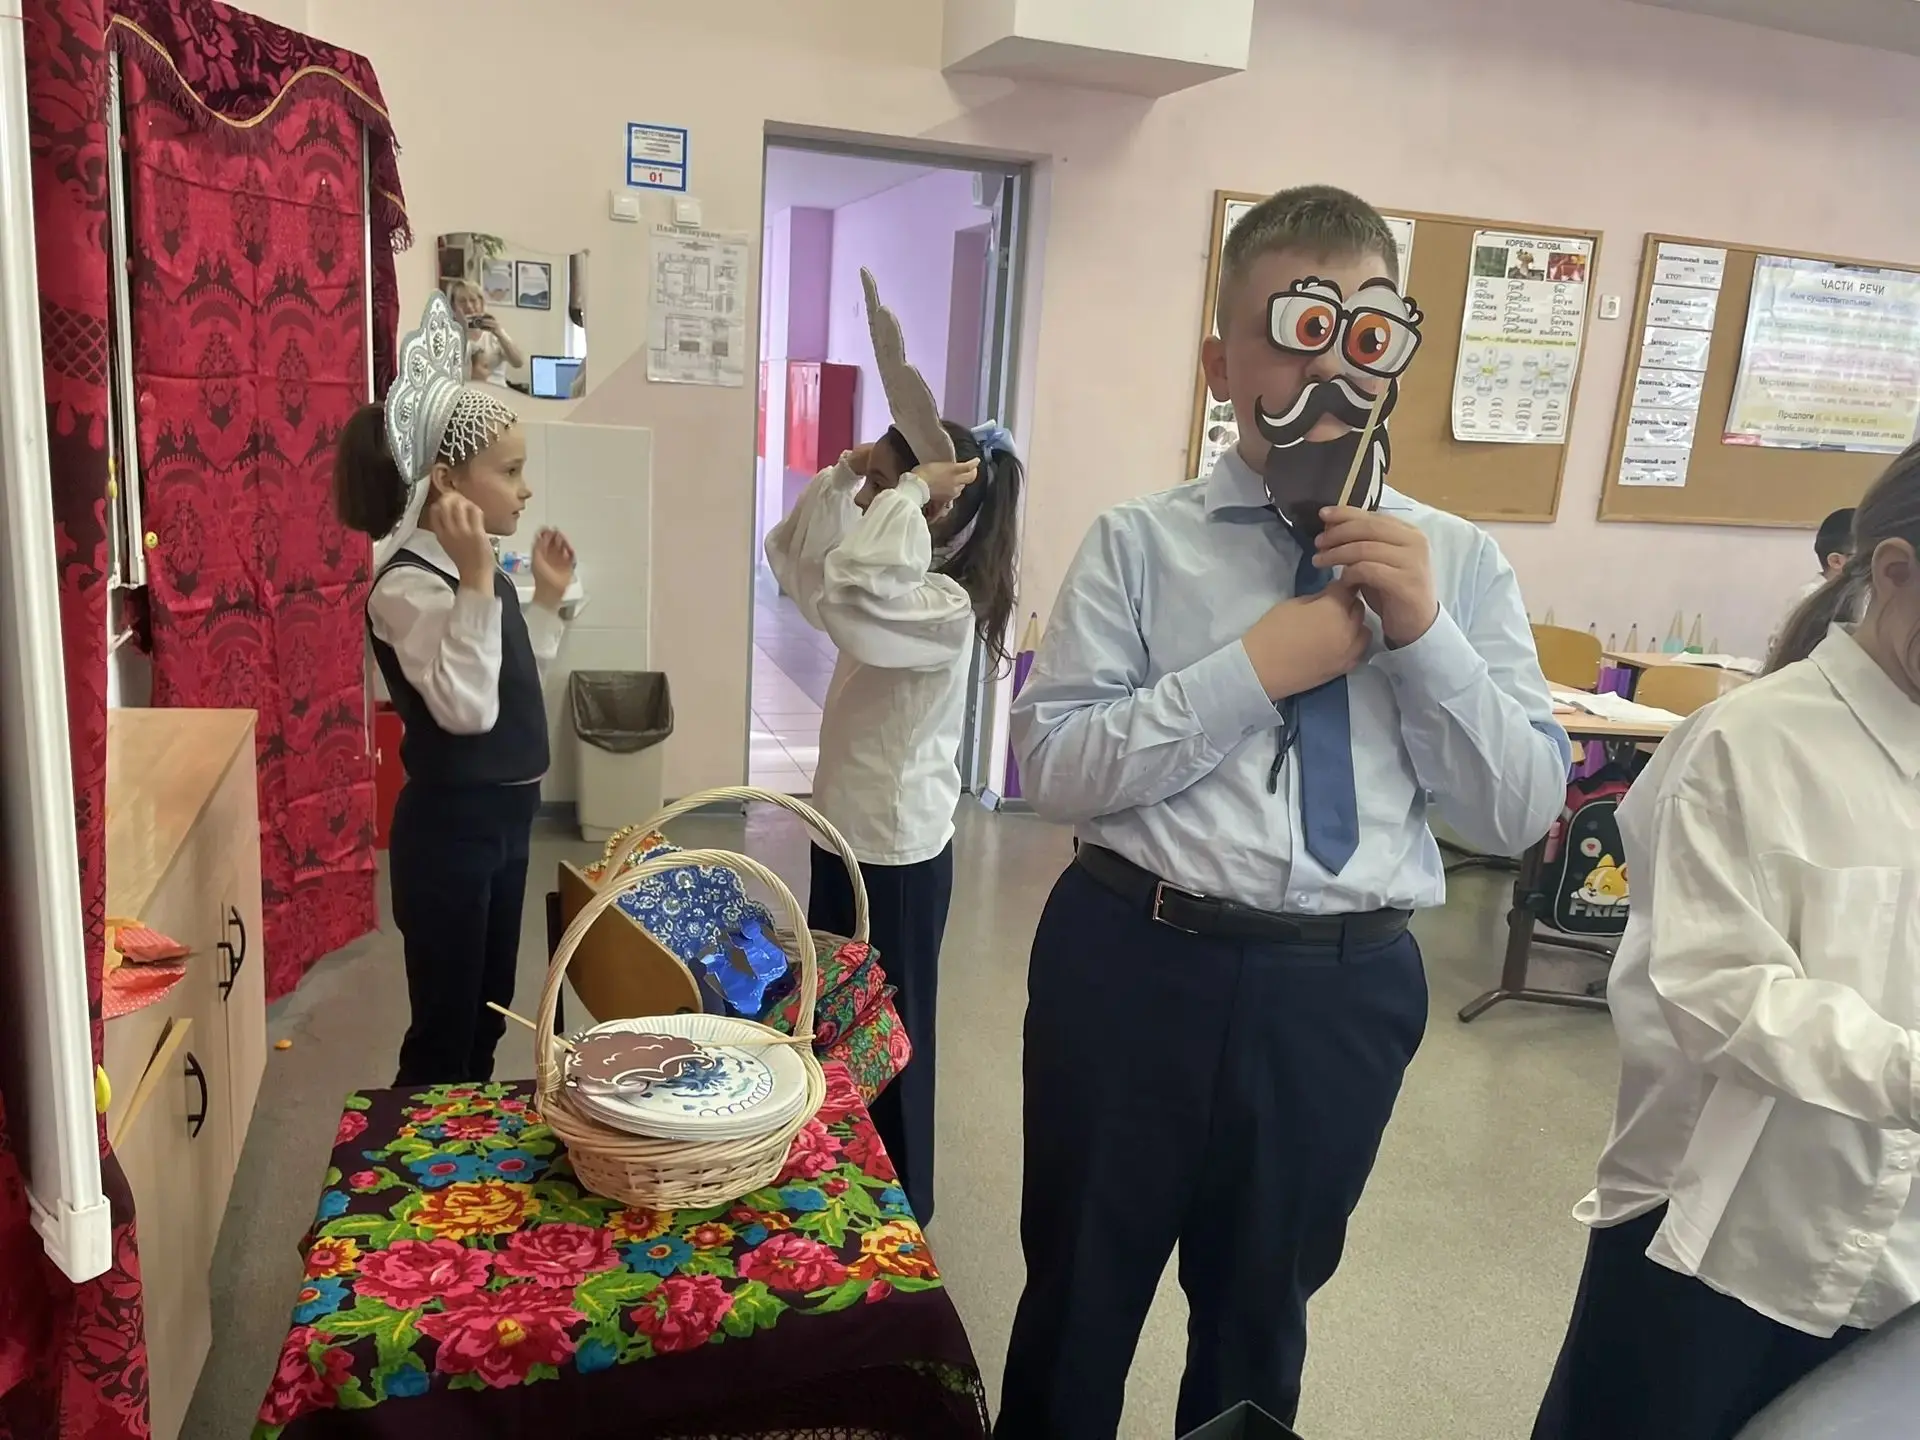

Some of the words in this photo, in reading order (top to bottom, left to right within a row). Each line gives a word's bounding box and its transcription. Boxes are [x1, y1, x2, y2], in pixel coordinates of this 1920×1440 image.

[649, 171, 663, 184] 01
[1505, 239, 1534, 249] КОРЕНЬ
[1536, 241, 1561, 250] СЛОВА
[1821, 279, 1854, 292] ЧАСТИ
[1859, 283, 1885, 295] РЕЧИ
[1807, 296, 1872, 306] существительное
[1778, 410, 1814, 420] Предлоги
[1568, 899, 1629, 917] FRIE
